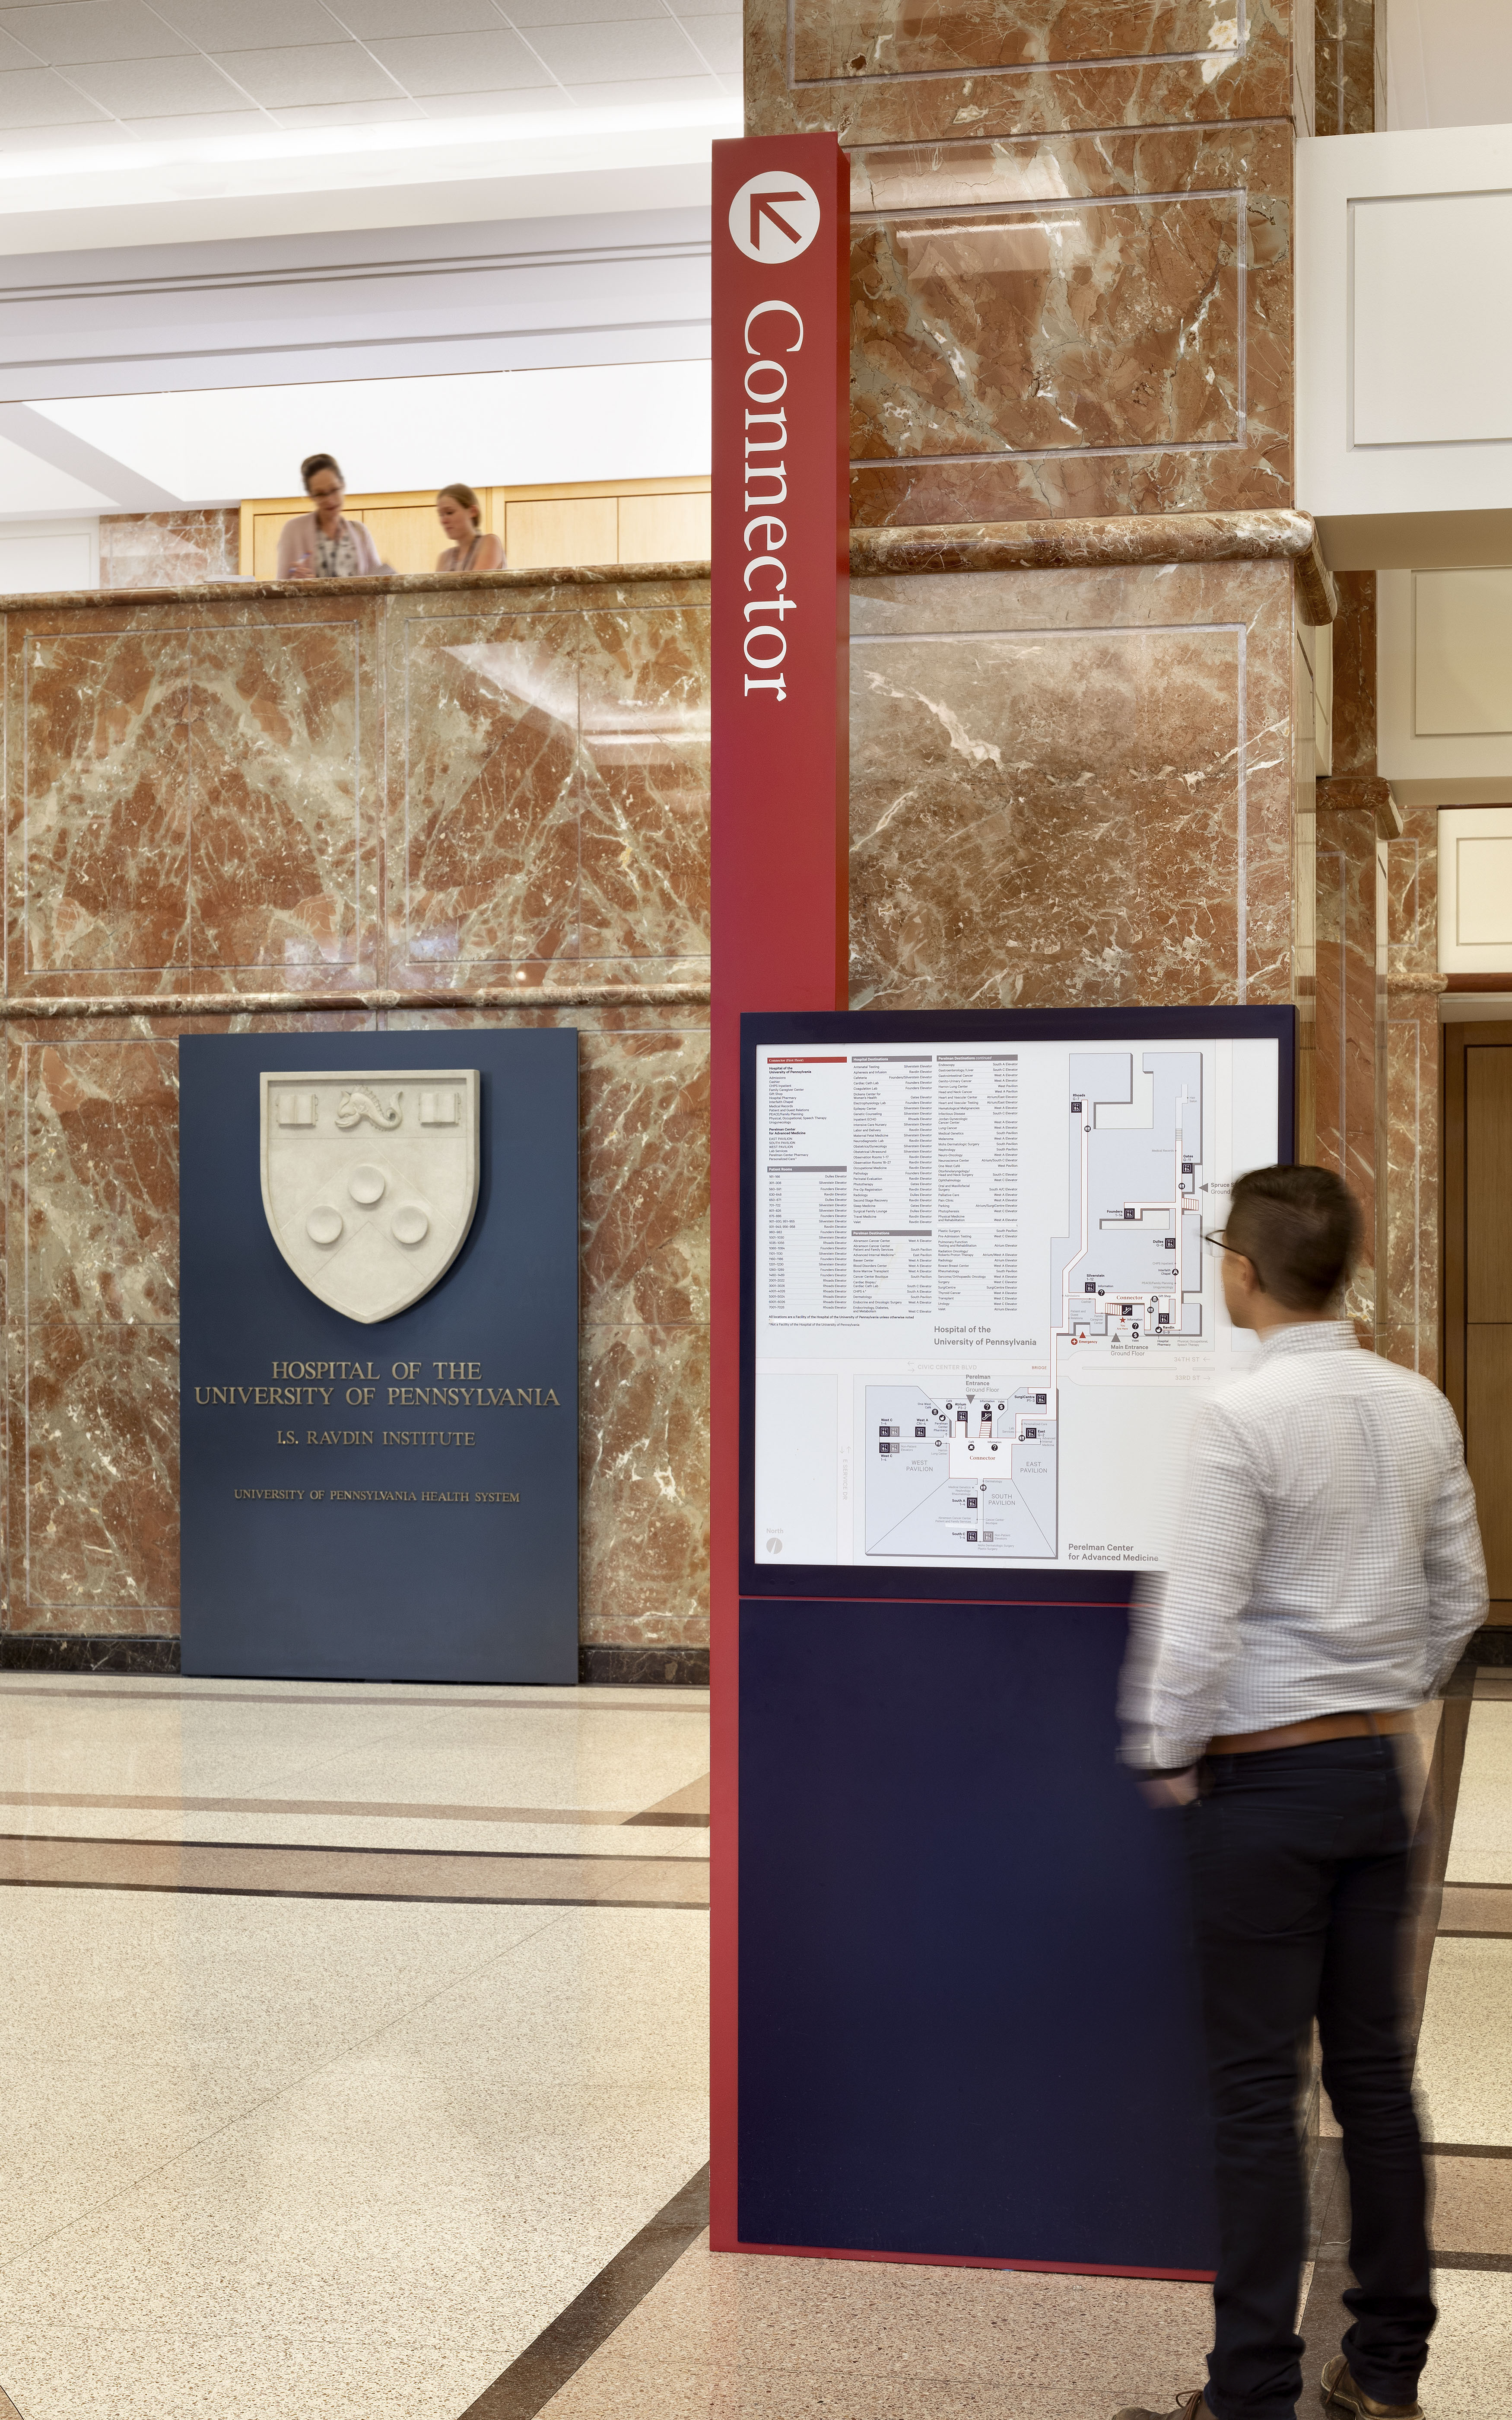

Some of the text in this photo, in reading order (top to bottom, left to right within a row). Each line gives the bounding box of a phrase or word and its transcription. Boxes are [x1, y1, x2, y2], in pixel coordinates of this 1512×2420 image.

[744, 300, 804, 701] Connector
[934, 1326, 966, 1334] Hospital
[934, 1338, 973, 1347] University
[986, 1338, 1036, 1347] Pennsylvania
[272, 1362, 482, 1379] HOSPITAL OF THE
[194, 1387, 560, 1405] UNIVERSITY OF PENNSYLVANIA
[278, 1431, 475, 1445] I.S. RAVDIN INSTITUTE
[235, 1490, 519, 1502] UNIVERSITY OF PENNSYLVANIA HEALTH SYSTEM
[843, 1492, 848, 1500] DR
